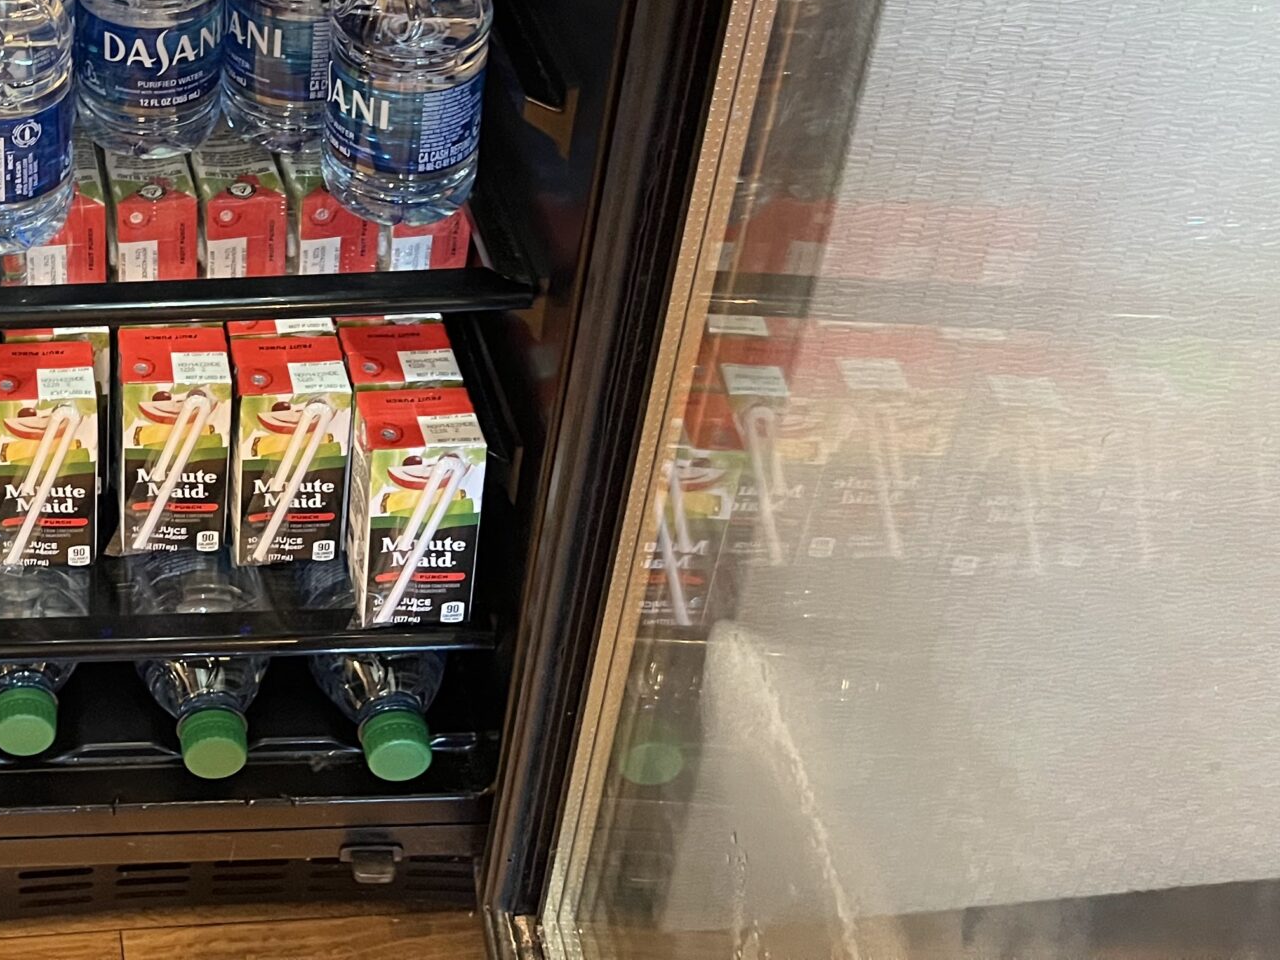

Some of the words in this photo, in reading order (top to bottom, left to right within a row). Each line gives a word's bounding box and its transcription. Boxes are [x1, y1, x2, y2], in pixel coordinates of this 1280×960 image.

[137, 79, 177, 89] PURIFIED
[178, 70, 204, 85] WATER
[139, 98, 149, 107] 12
[150, 98, 160, 107] FL
[161, 97, 171, 106] OZ
[418, 152, 429, 163] CA
[430, 147, 448, 161] CASH
[158, 526, 187, 535] JUICE
[202, 533, 215, 542] 90
[274, 536, 303, 544] JUICE
[29, 541, 58, 550] JUICE
[318, 542, 331, 551] 90
[73, 548, 86, 557] 90
[268, 553, 281, 561] (177
[401, 597, 431, 606] JUICE
[446, 604, 460, 614] 90
